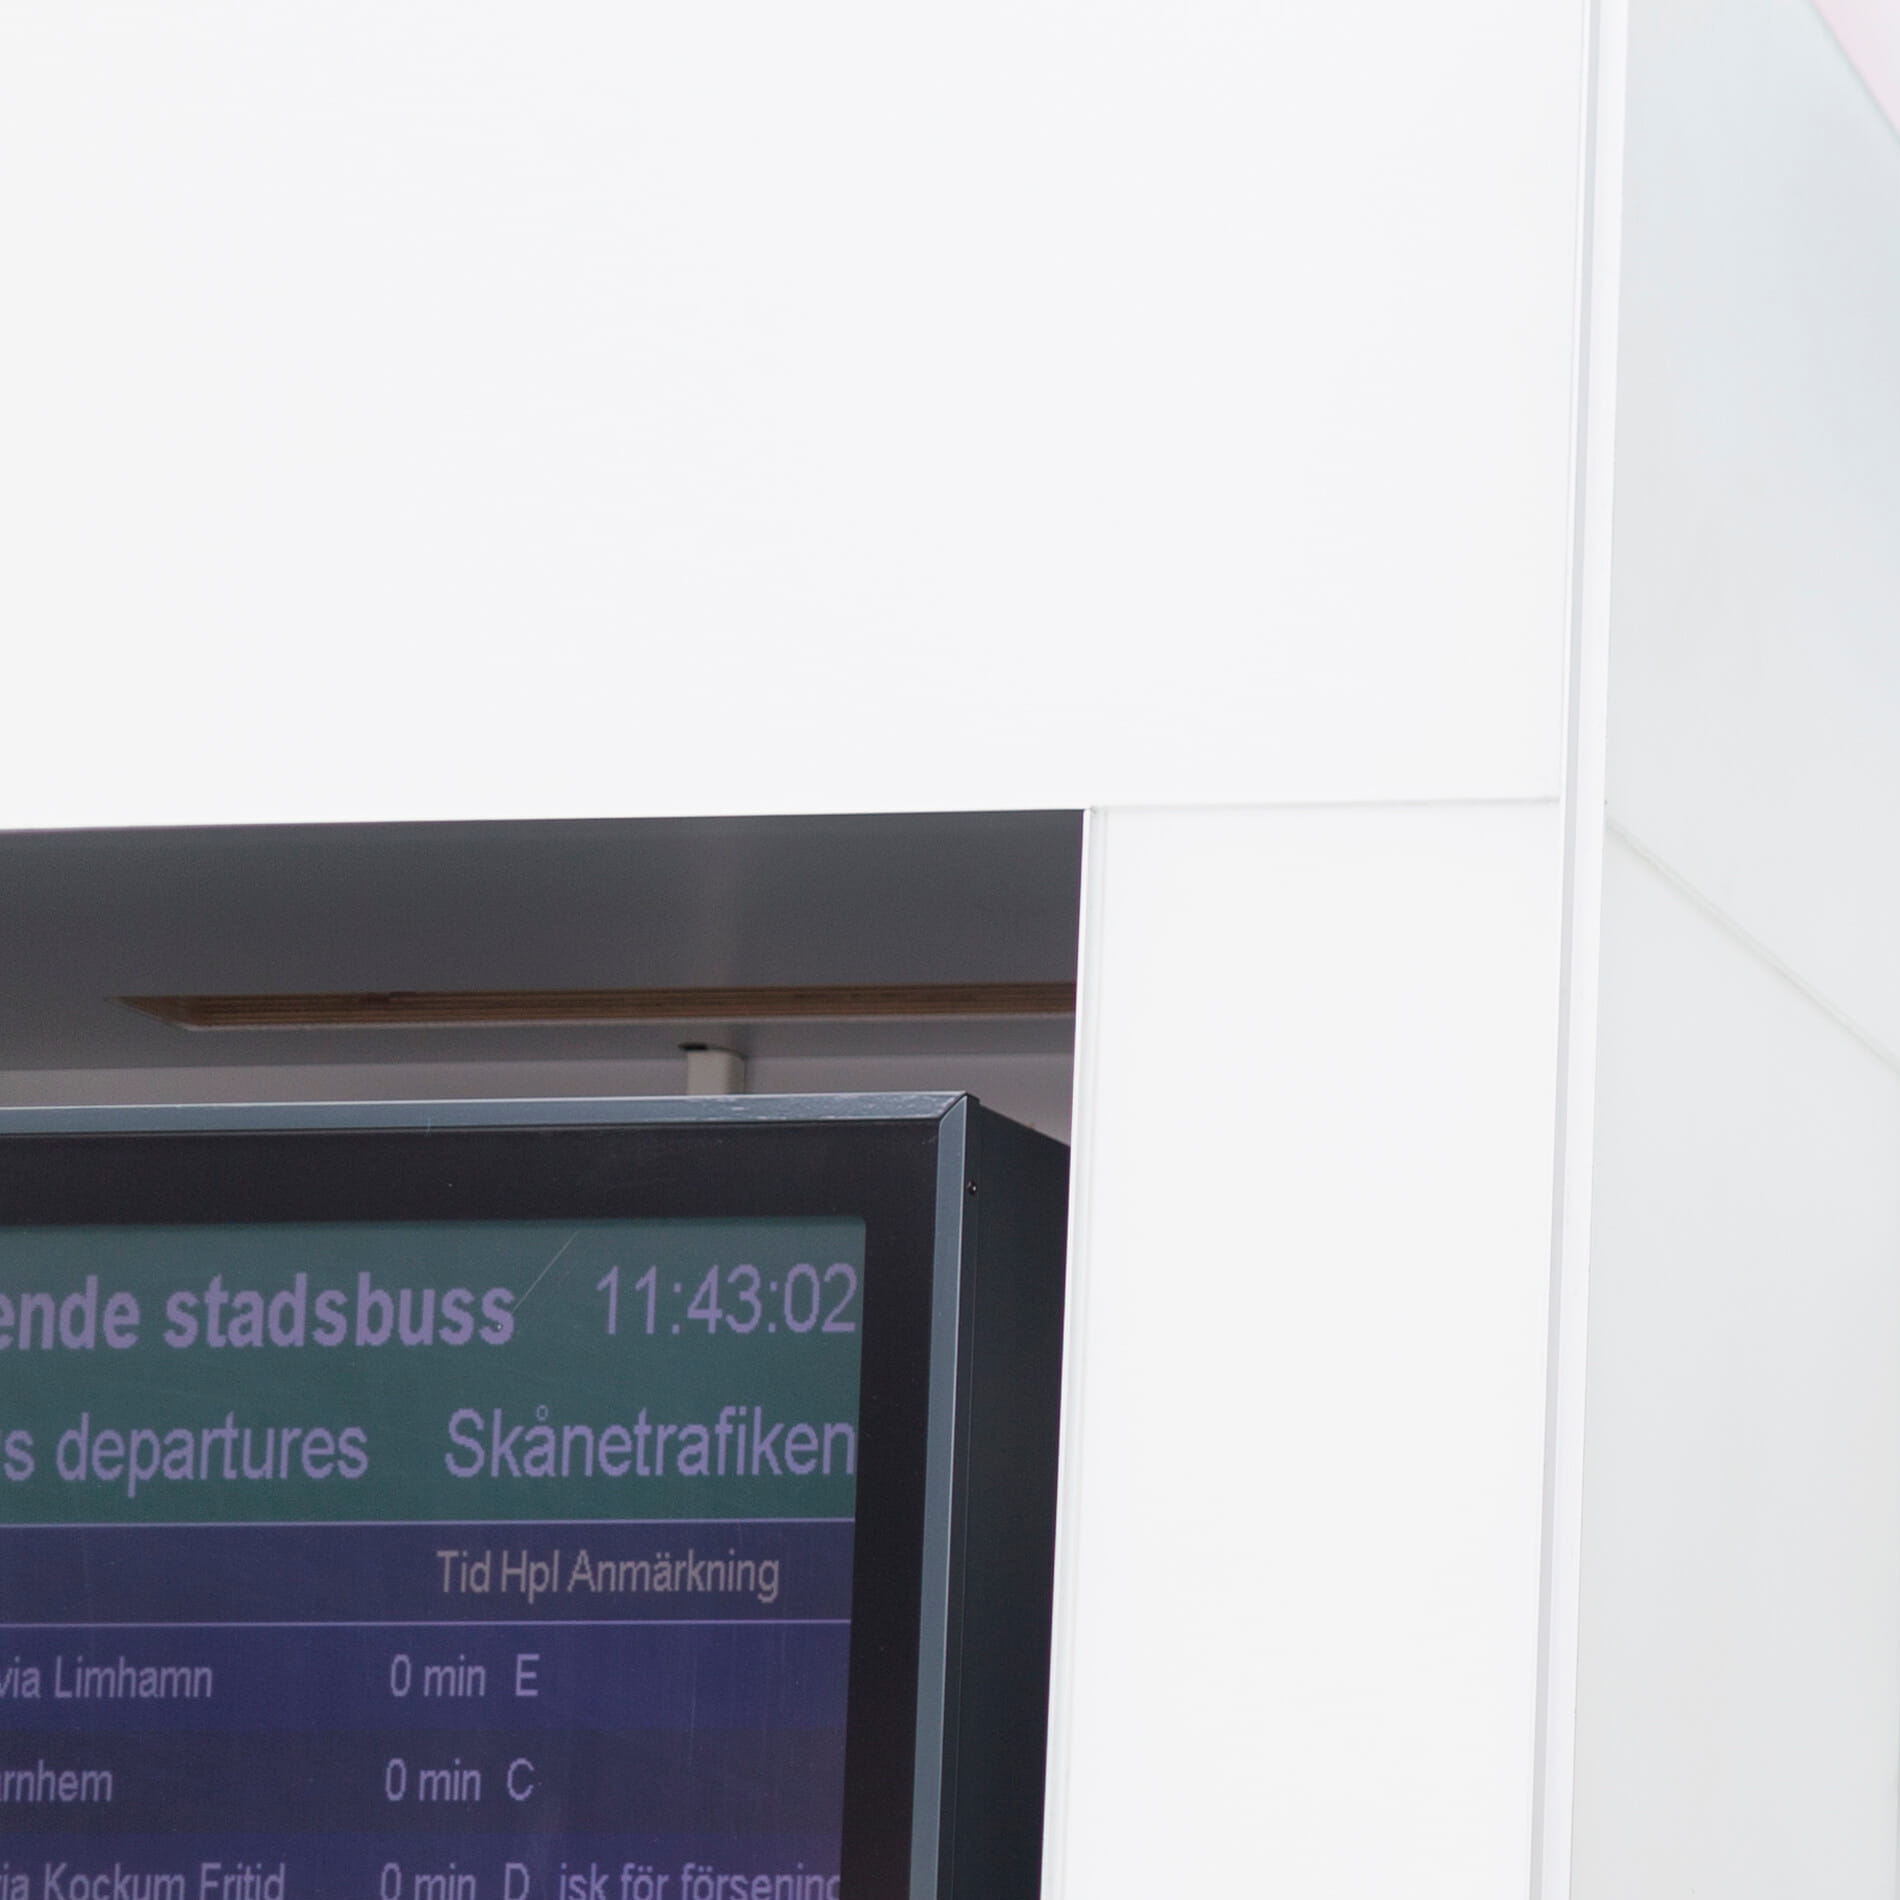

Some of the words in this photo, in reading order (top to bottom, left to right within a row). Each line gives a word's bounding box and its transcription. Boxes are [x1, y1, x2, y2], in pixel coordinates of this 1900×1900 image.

[165, 1271, 517, 1348] stadsbuss
[596, 1261, 856, 1335] 11:43:02
[0, 1430, 35, 1481] s
[56, 1411, 368, 1497] departures
[445, 1403, 855, 1478] Skånetrafiken
[437, 1550, 491, 1594] Tid
[499, 1548, 561, 1603] Hpl
[567, 1547, 779, 1602] Anmärkning
[54, 1655, 212, 1699] Limhamn
[390, 1654, 410, 1698] 0
[423, 1655, 485, 1698] min
[515, 1652, 540, 1698] E
[385, 1758, 406, 1802] 0
[420, 1759, 481, 1802] min
[506, 1757, 536, 1802] C
